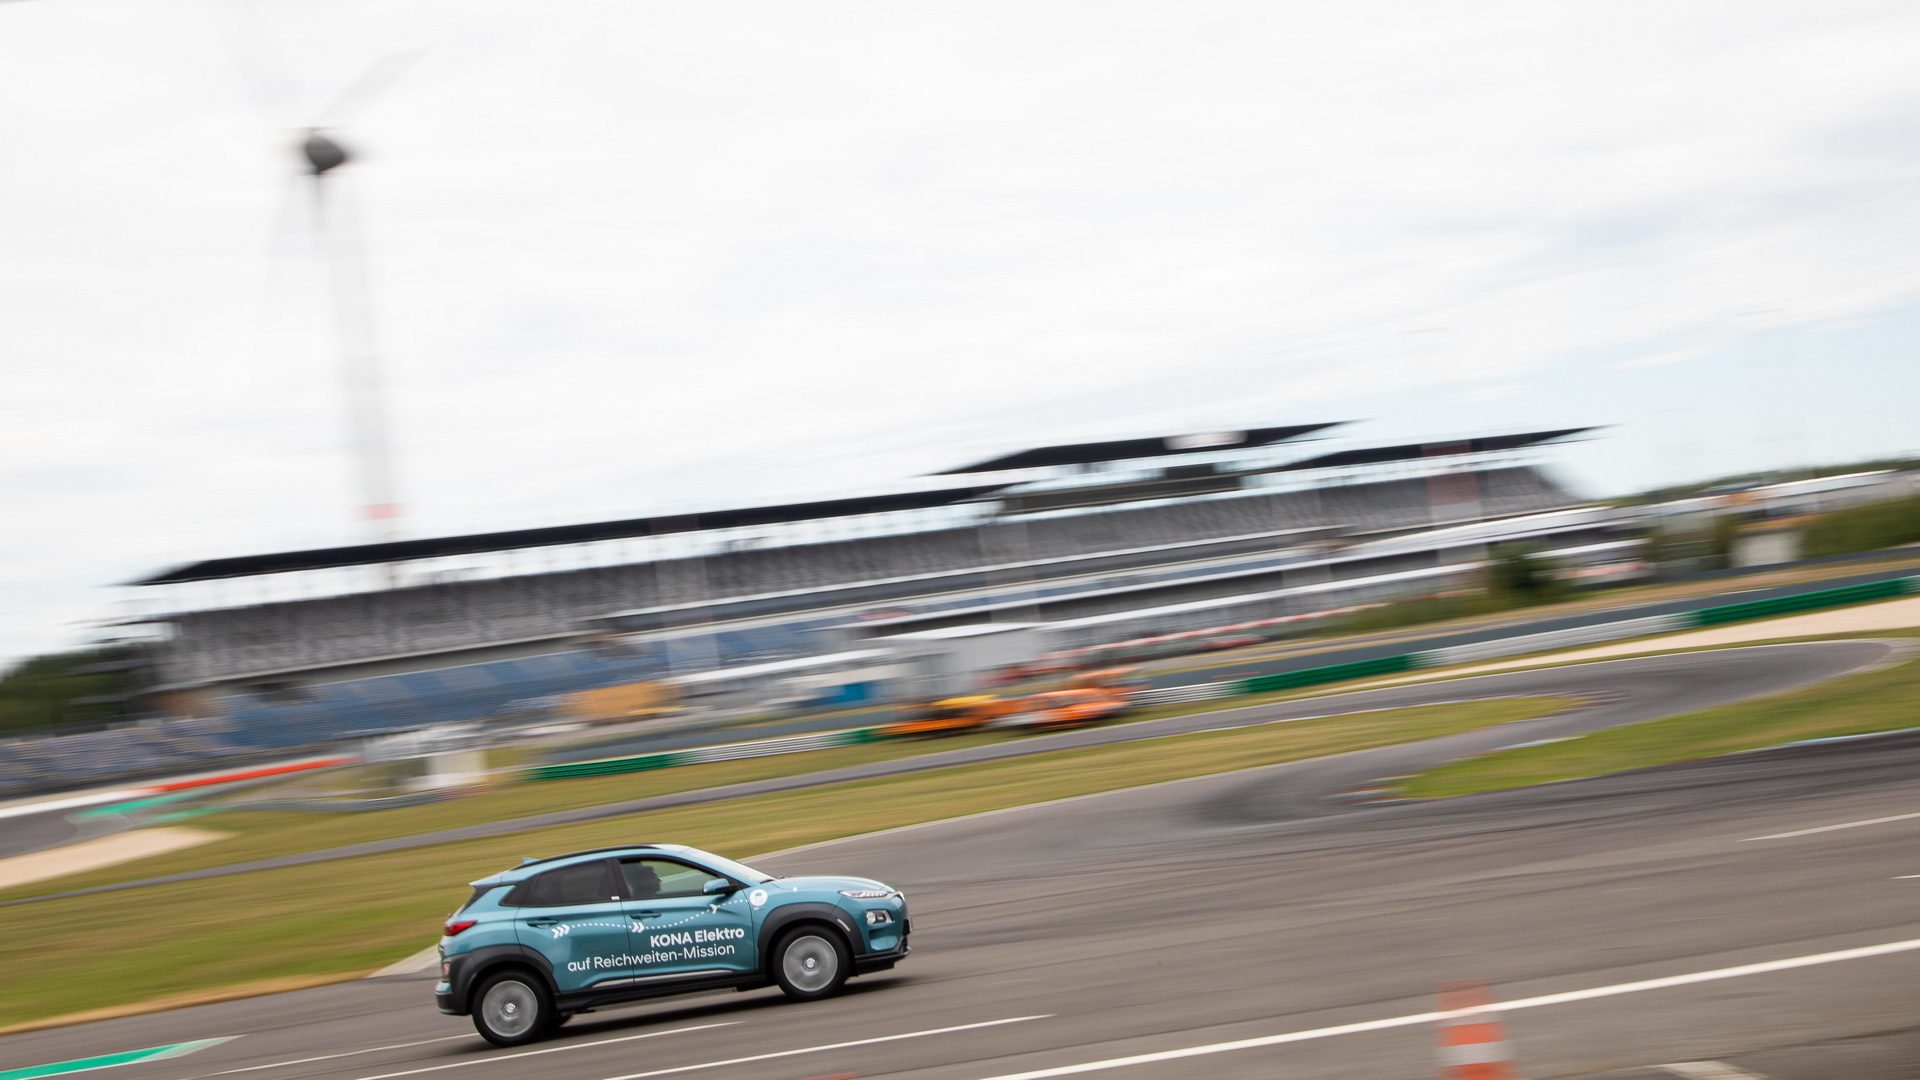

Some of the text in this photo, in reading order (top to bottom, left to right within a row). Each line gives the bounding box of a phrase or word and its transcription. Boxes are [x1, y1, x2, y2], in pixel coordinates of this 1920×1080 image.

[650, 927, 745, 948] KONA Elektro
[567, 943, 735, 972] auf Reichweiten-Mission
